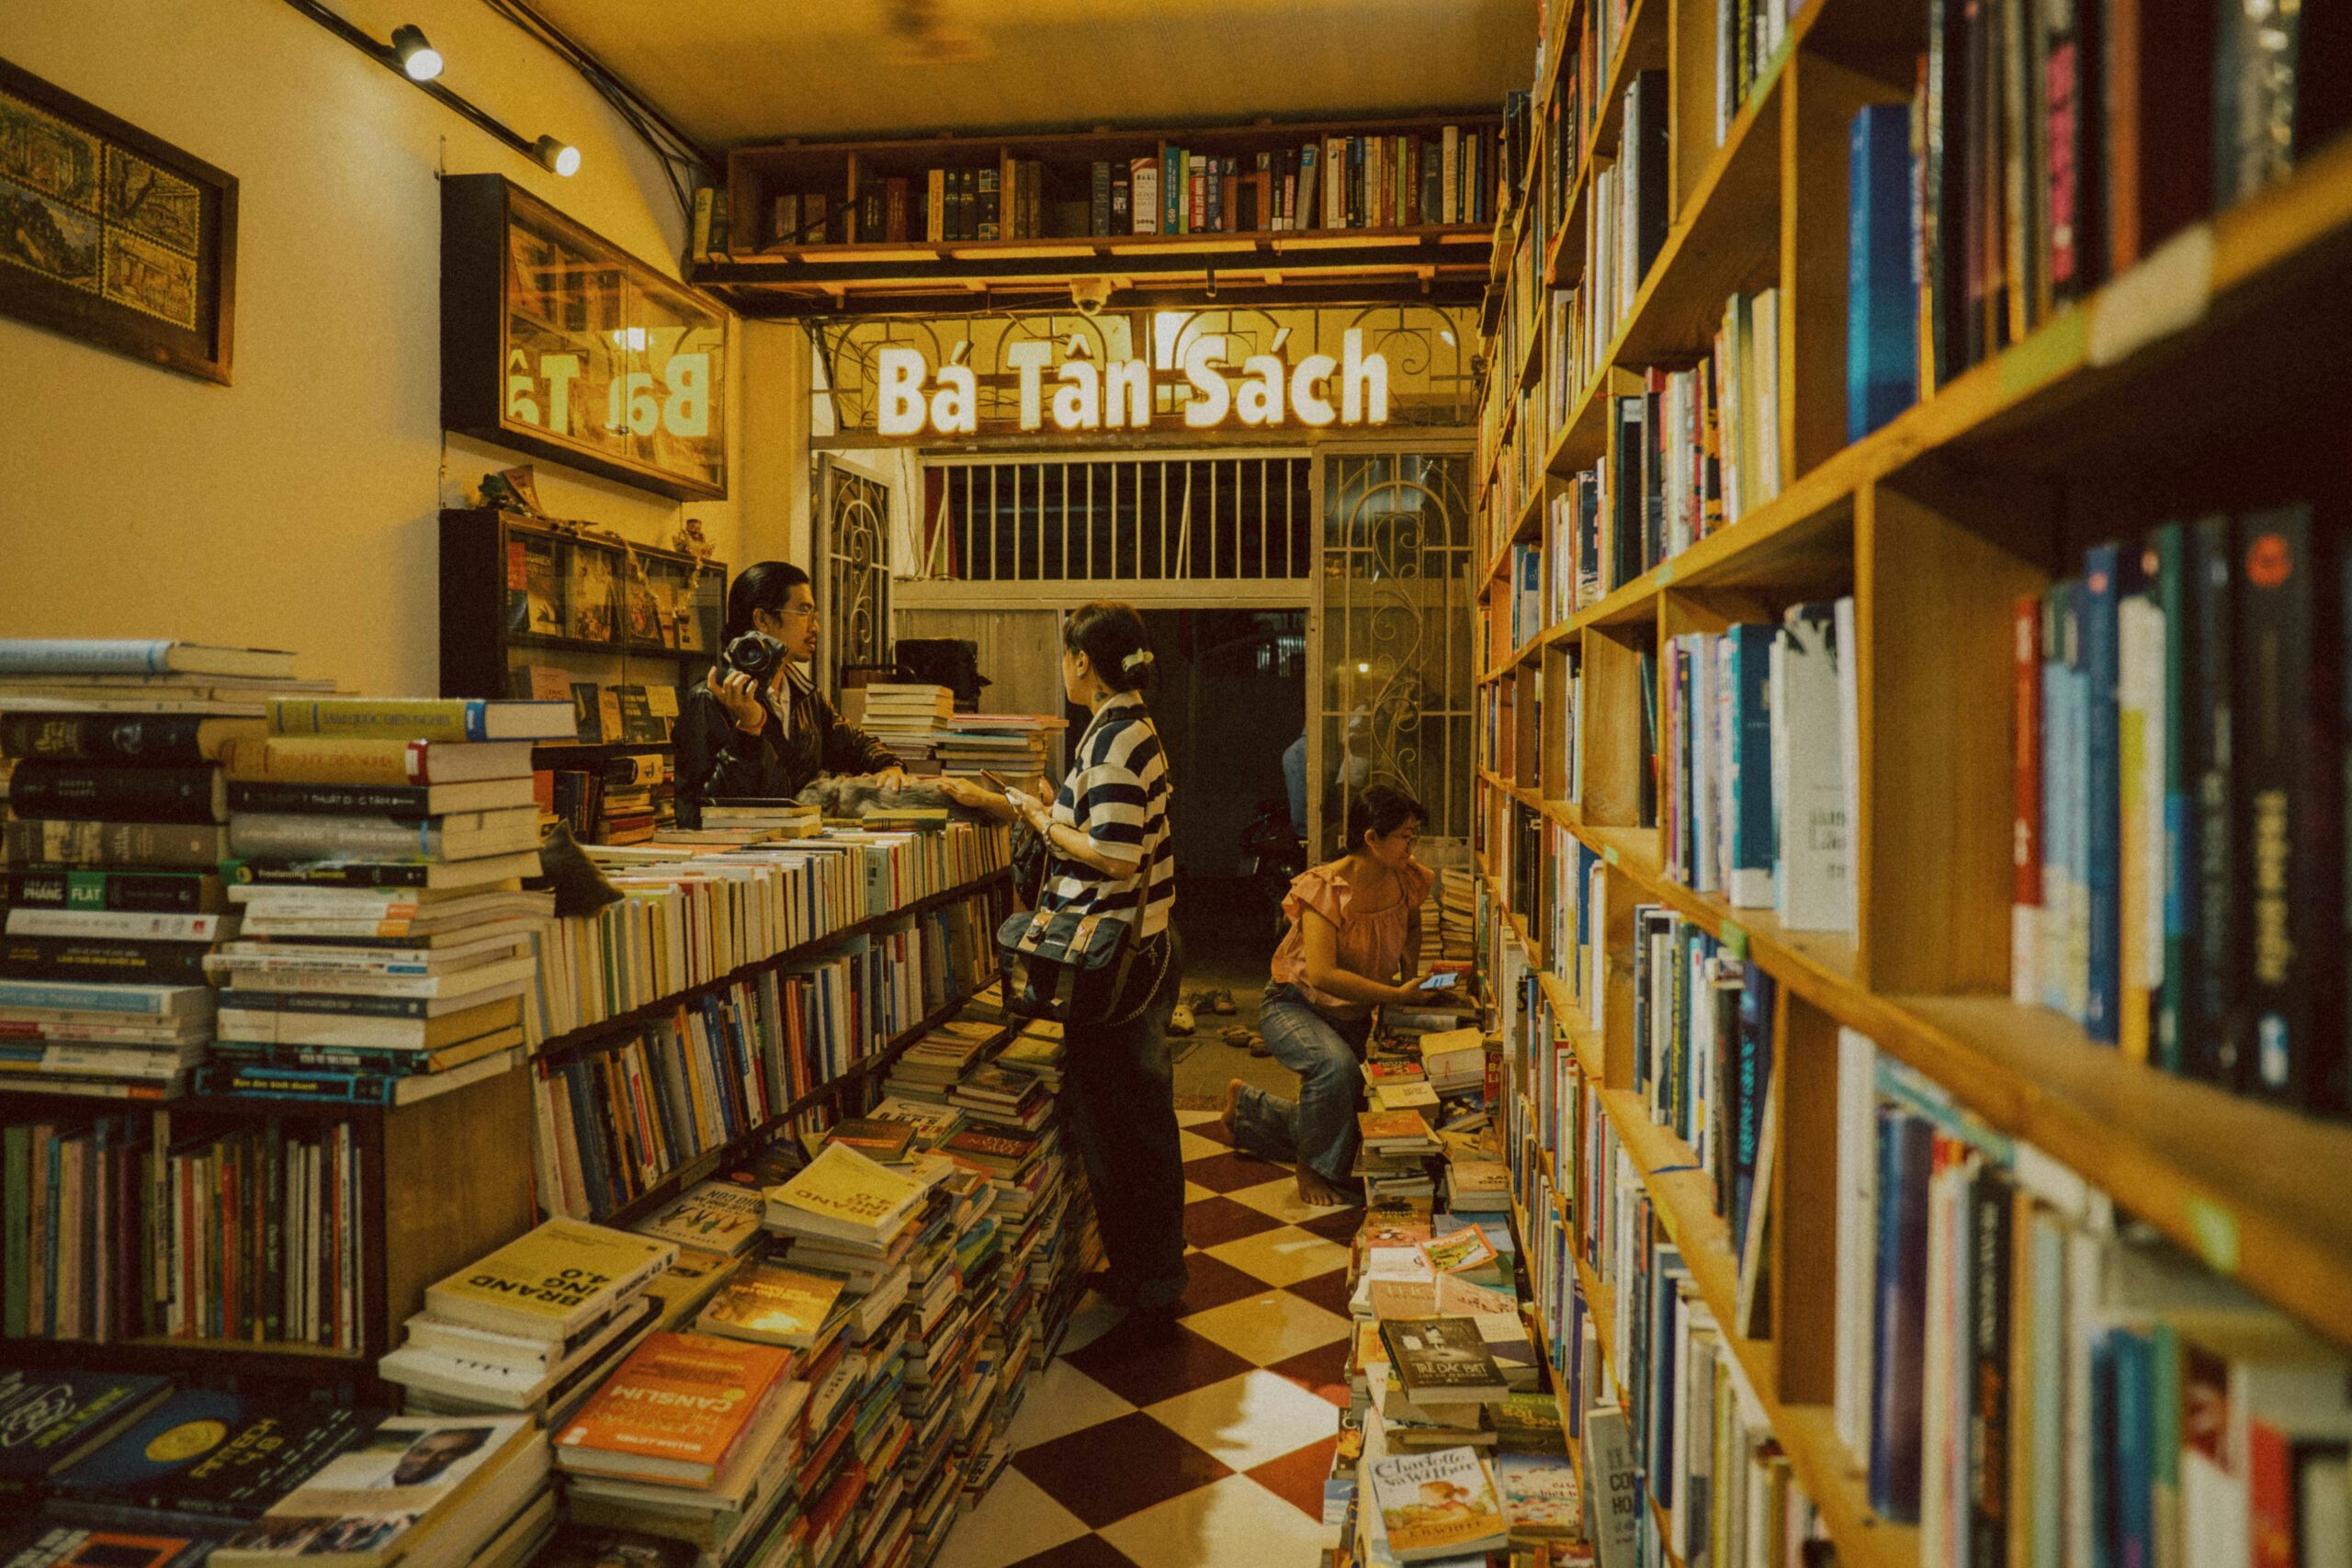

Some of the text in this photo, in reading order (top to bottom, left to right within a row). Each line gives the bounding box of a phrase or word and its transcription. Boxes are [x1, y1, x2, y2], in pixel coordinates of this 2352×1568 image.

[876, 327, 1389, 436] Bá Tân Sách
[71, 887, 102, 901] FLAT
[795, 1189, 881, 1218] BRAND
[846, 1196, 889, 1213] ING
[542, 1277, 602, 1296] ING
[560, 1268, 611, 1283] 4.0
[468, 1274, 585, 1307] BRAND
[609, 1383, 733, 1414] CANSLIM
